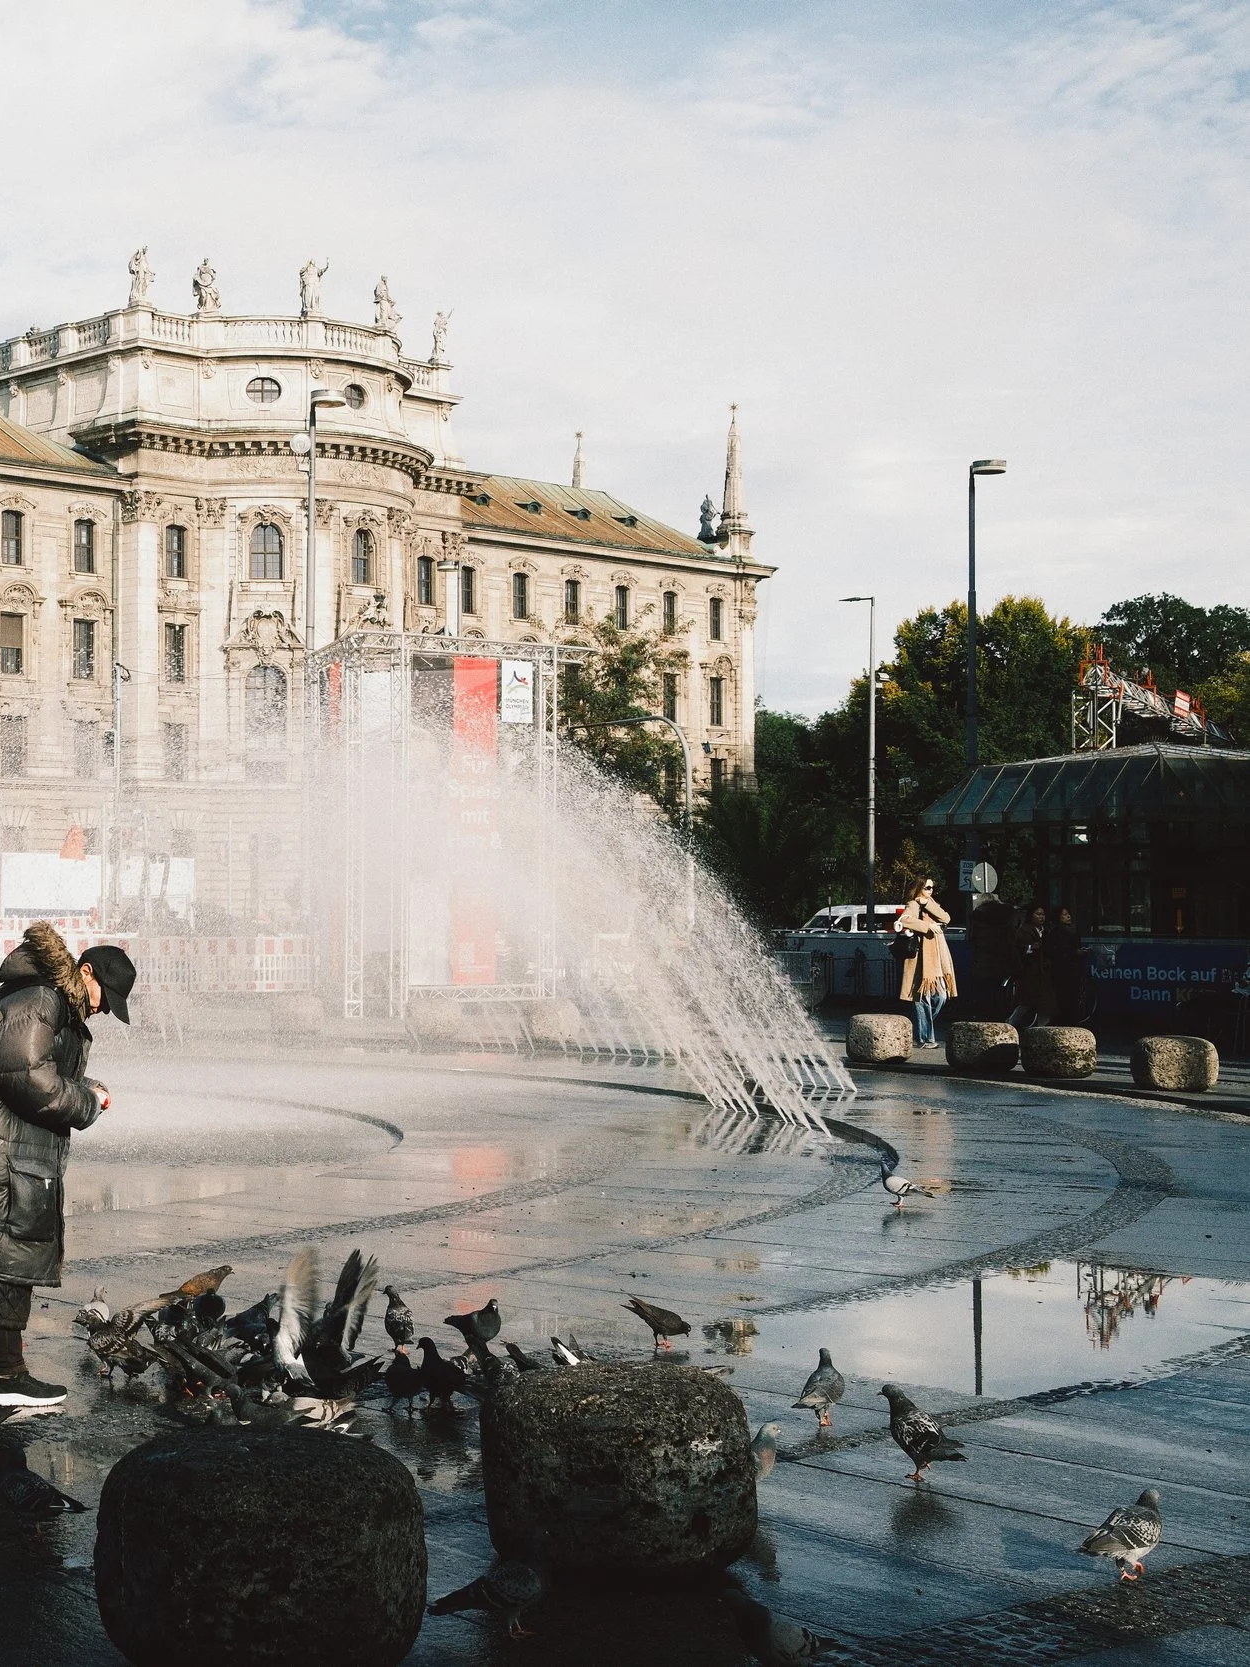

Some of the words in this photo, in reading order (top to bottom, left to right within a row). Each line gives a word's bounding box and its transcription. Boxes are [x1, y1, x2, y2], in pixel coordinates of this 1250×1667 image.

[460, 808, 490, 825] mit
[1147, 966, 1187, 982] Bock
[1190, 967, 1217, 983] auf
[1130, 986, 1171, 1001] Dann
